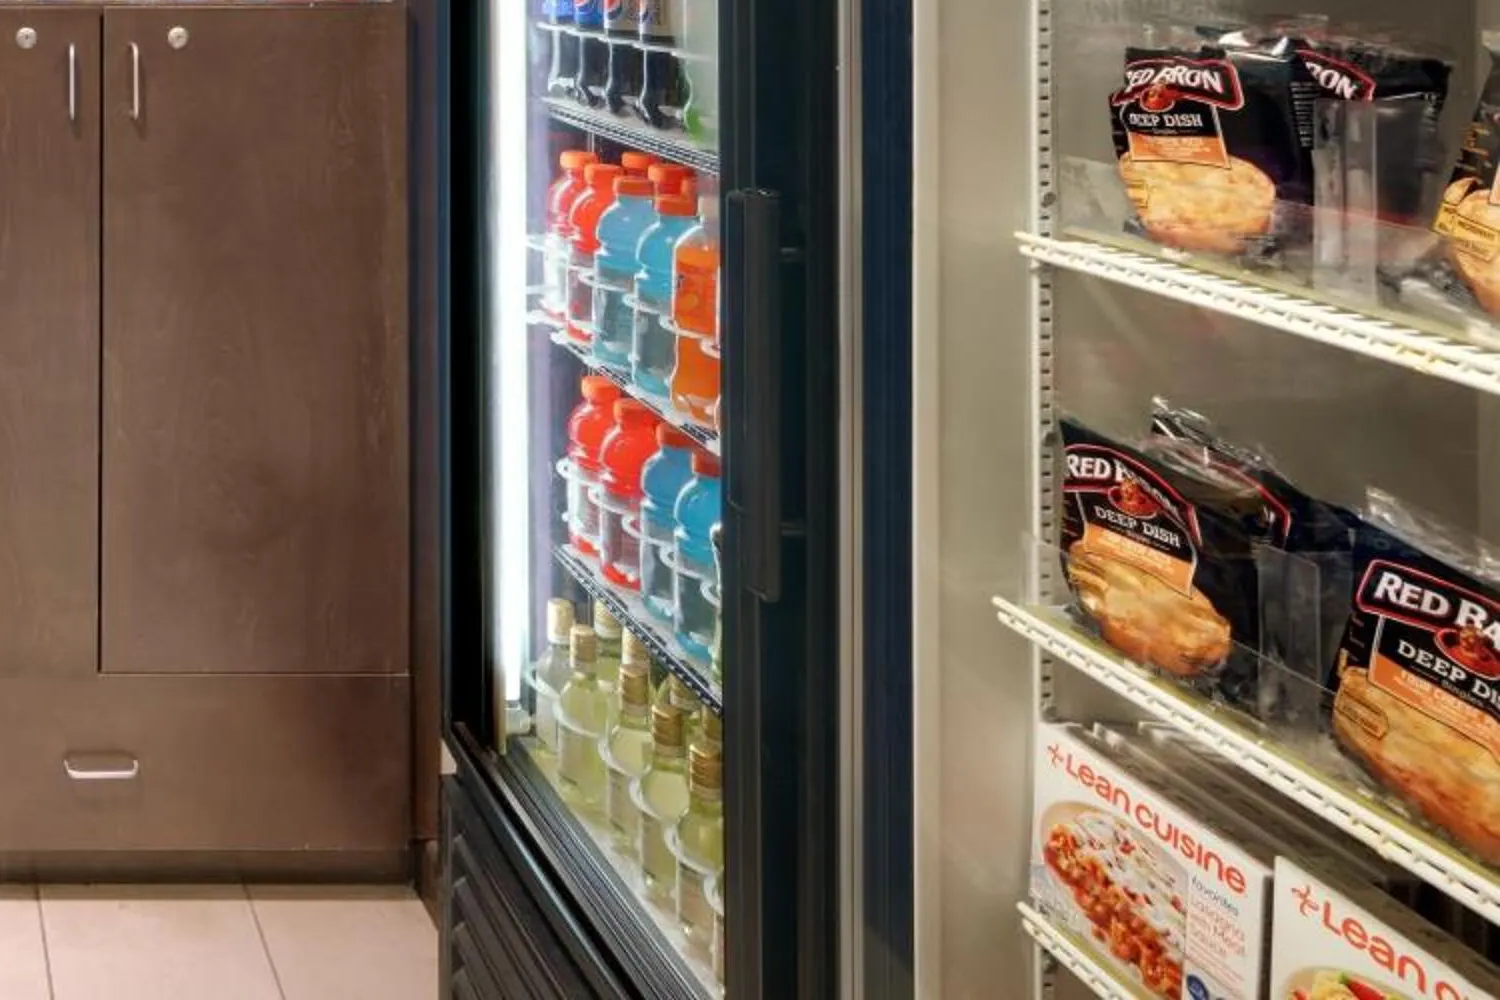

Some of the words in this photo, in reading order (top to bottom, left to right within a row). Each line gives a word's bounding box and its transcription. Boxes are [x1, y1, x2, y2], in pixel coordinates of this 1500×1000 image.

[1163, 113, 1204, 127] DISH
[1066, 454, 1111, 480] RED
[1094, 505, 1137, 530] DEEP
[1142, 522, 1181, 548] DISH
[1373, 570, 1450, 617] RED
[1397, 639, 1467, 683] DEEP
[1064, 753, 1131, 815] Lean
[1322, 900, 1428, 994] Lean
